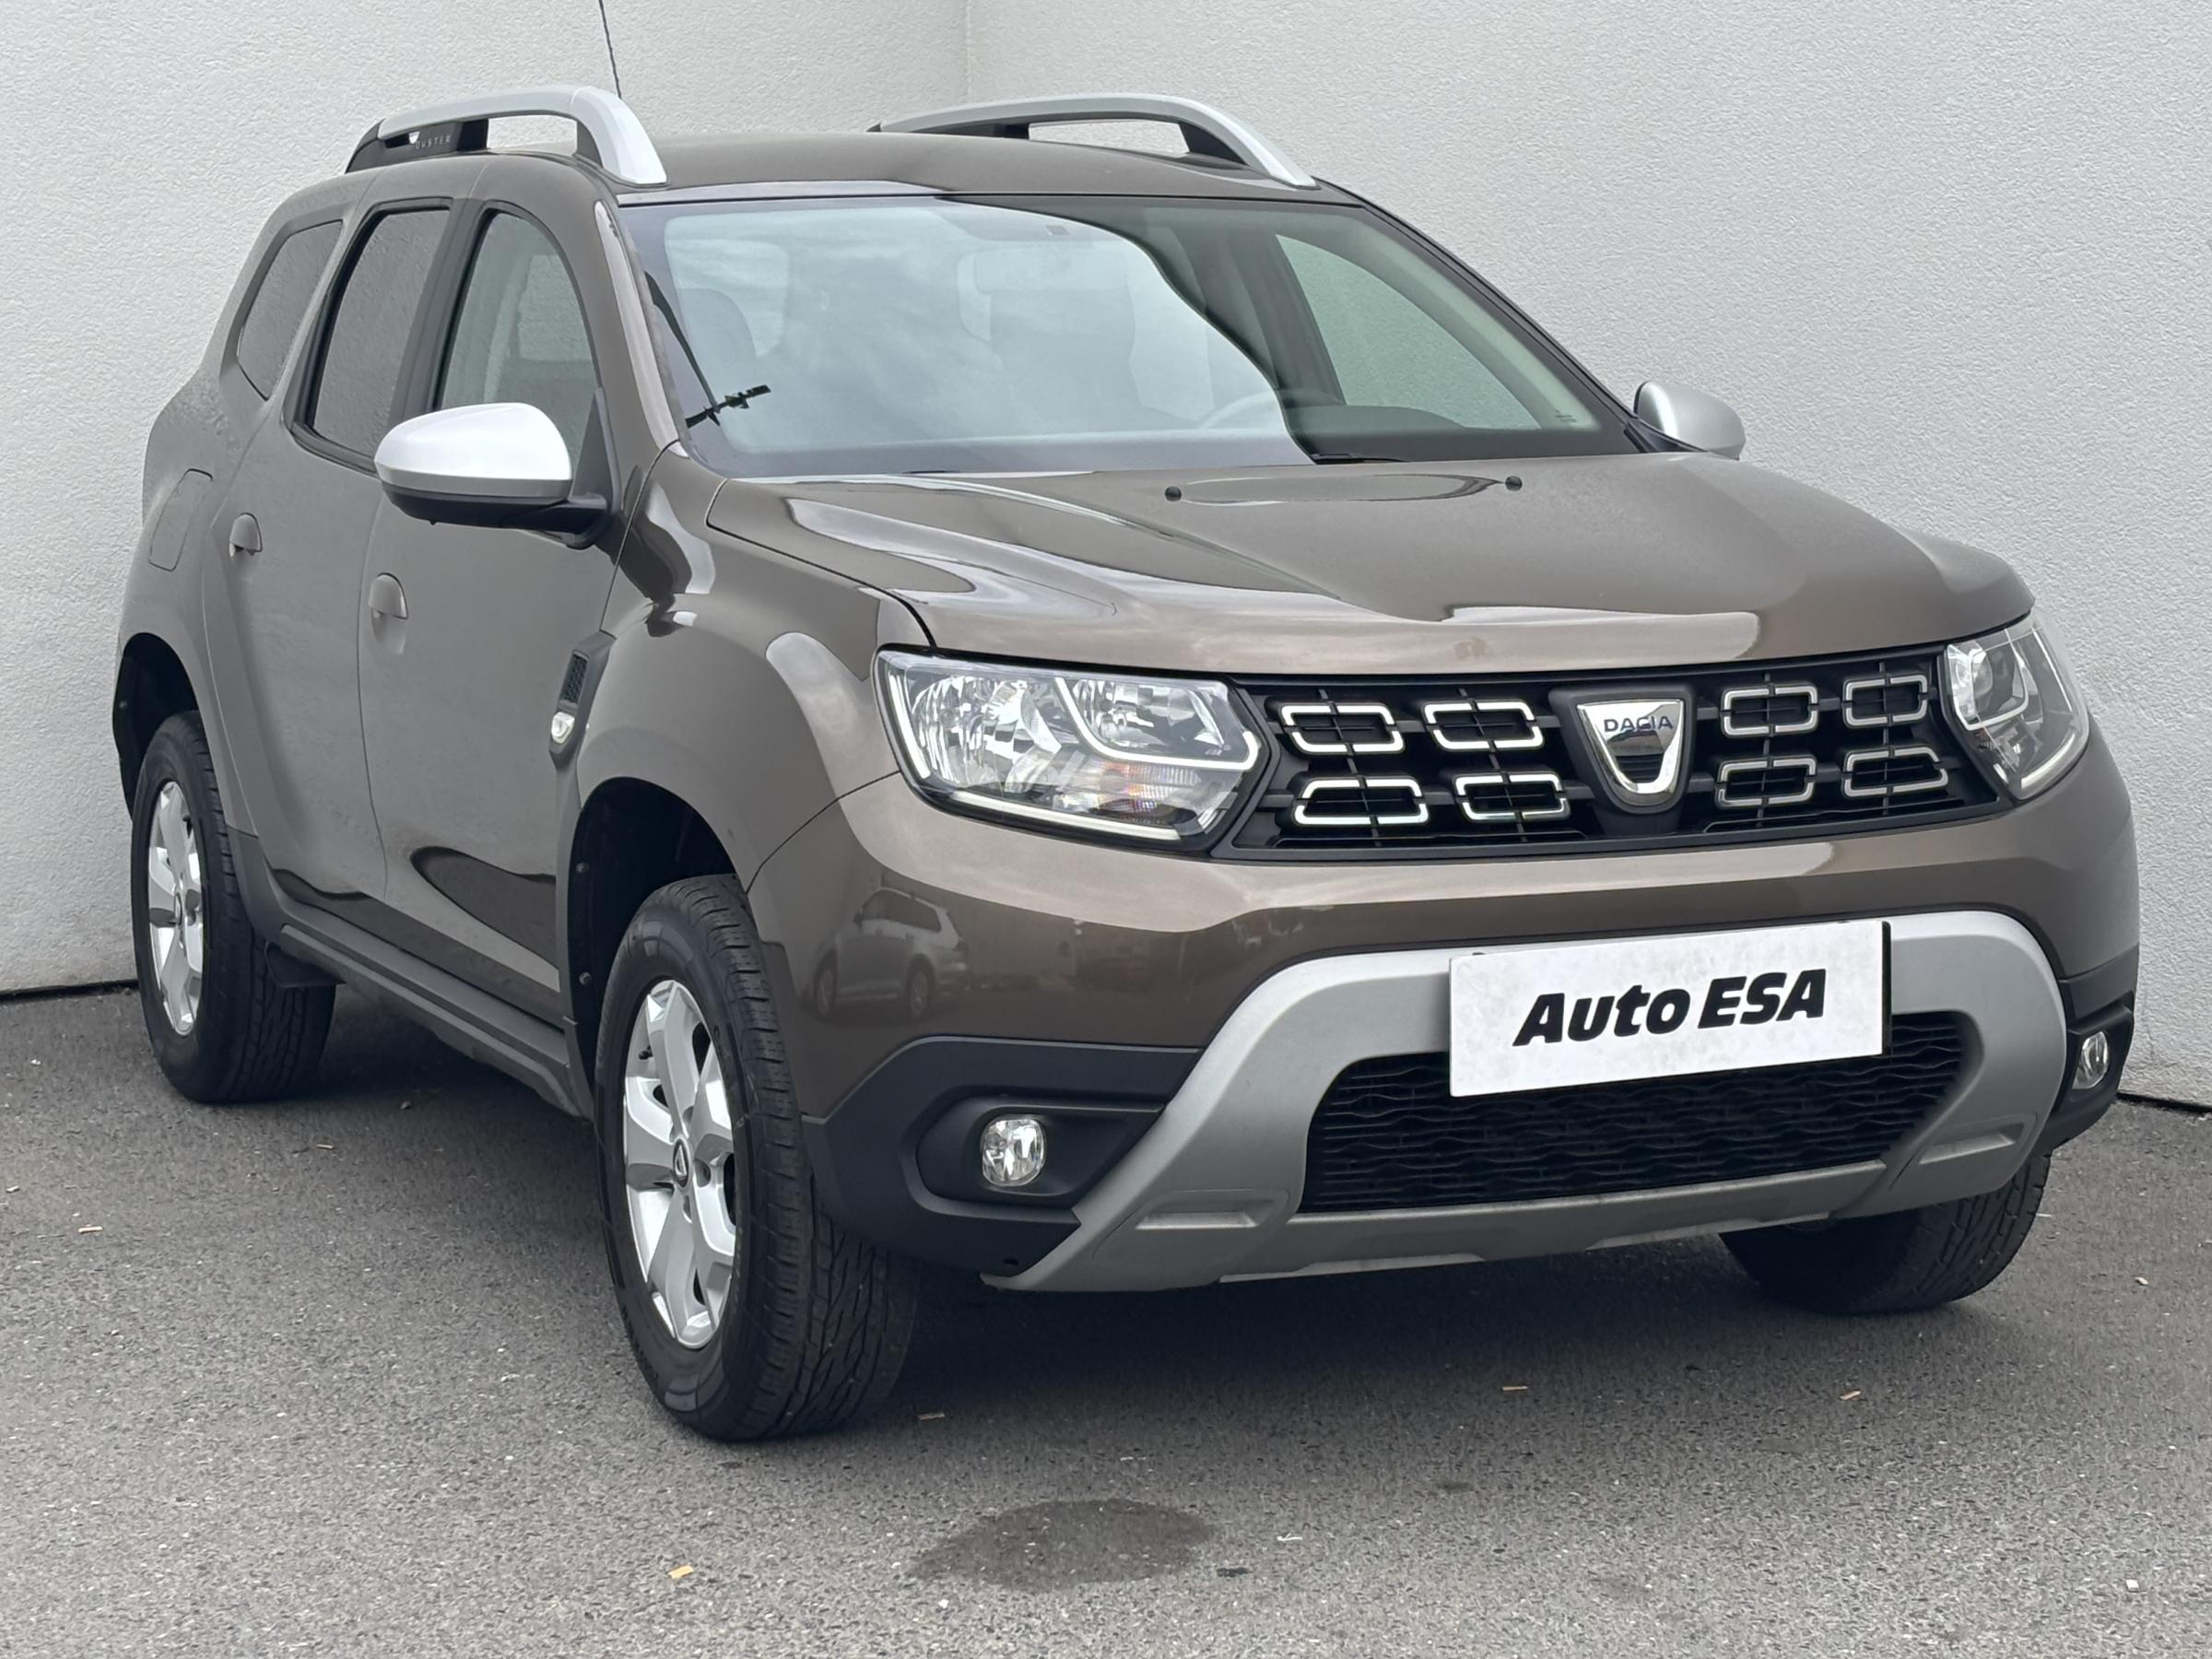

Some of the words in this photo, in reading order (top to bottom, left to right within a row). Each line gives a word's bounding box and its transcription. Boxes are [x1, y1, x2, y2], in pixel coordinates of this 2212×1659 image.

[1604, 716, 1673, 733] DACIA
[1512, 985, 1691, 1047] Auto
[1698, 969, 1826, 1029] ESA
